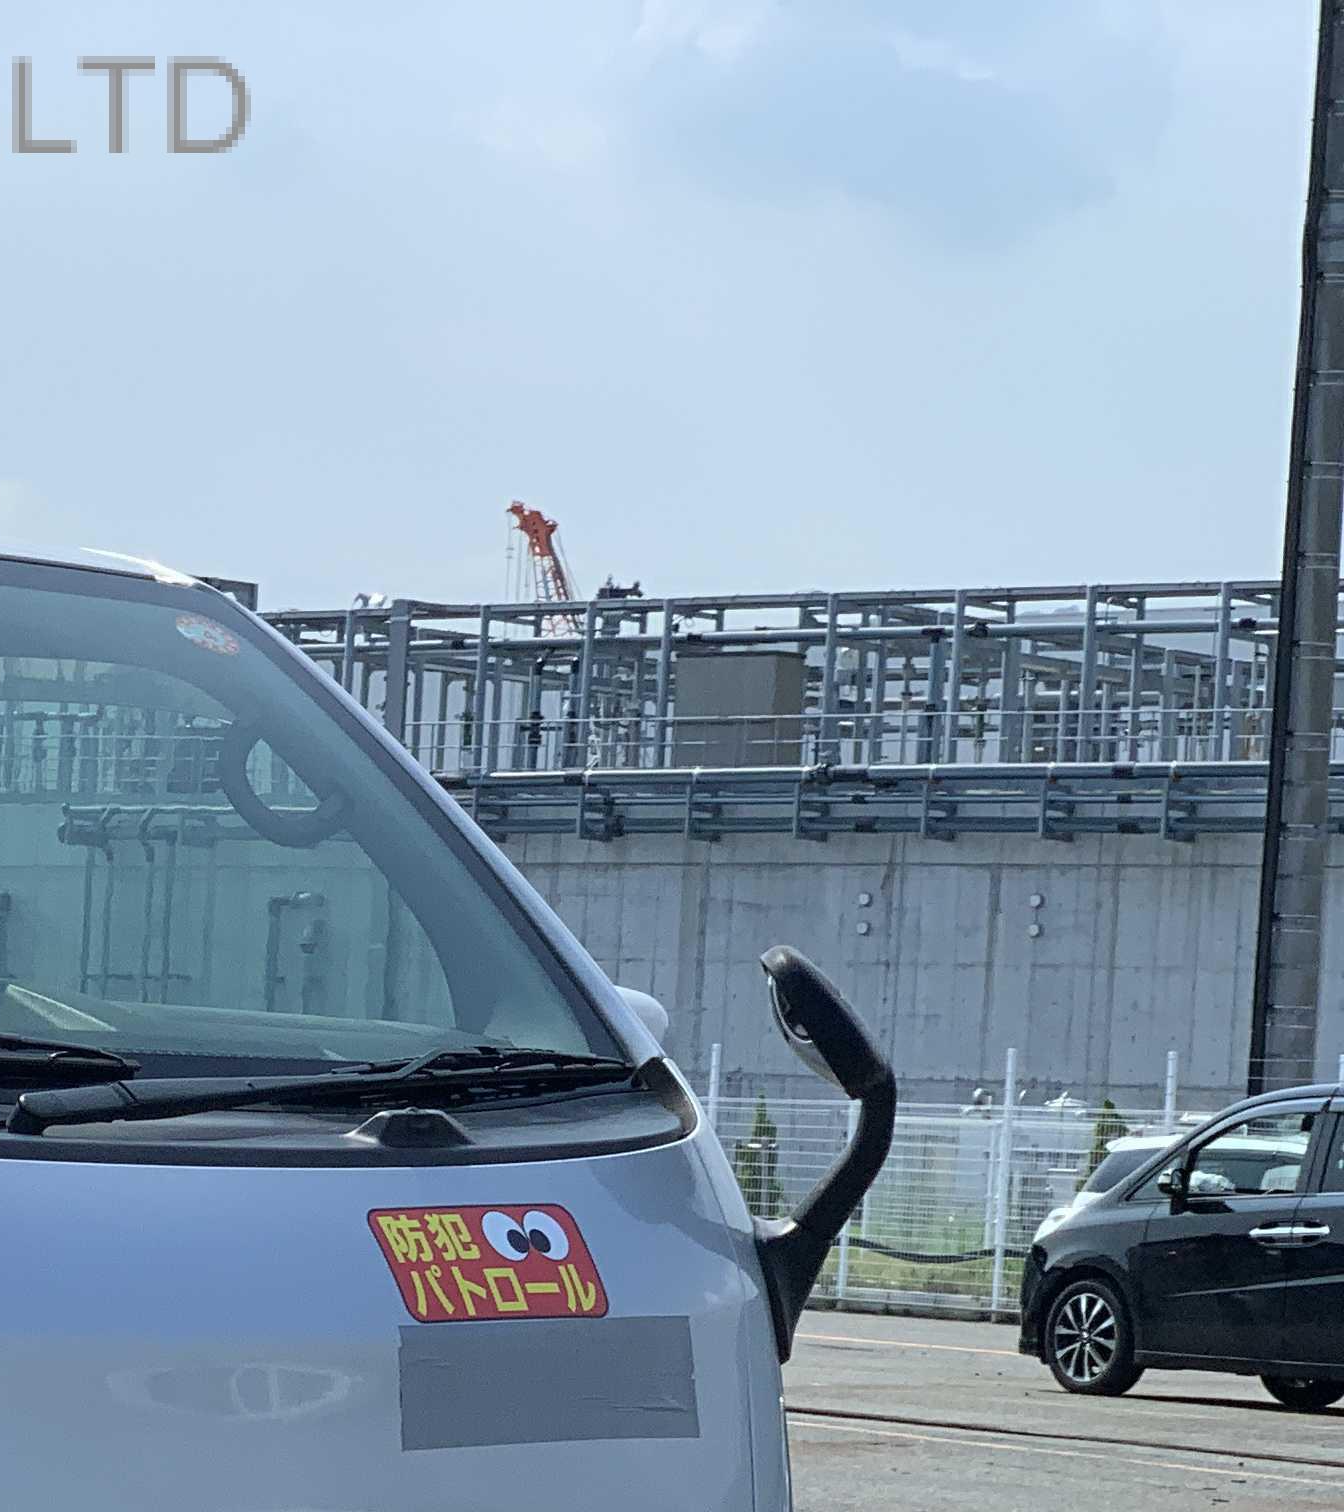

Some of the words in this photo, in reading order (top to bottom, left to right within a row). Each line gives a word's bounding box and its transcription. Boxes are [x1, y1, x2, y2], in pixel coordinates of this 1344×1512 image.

[378, 1212, 481, 1263] 防犯
[410, 1263, 597, 1317] パトロール
